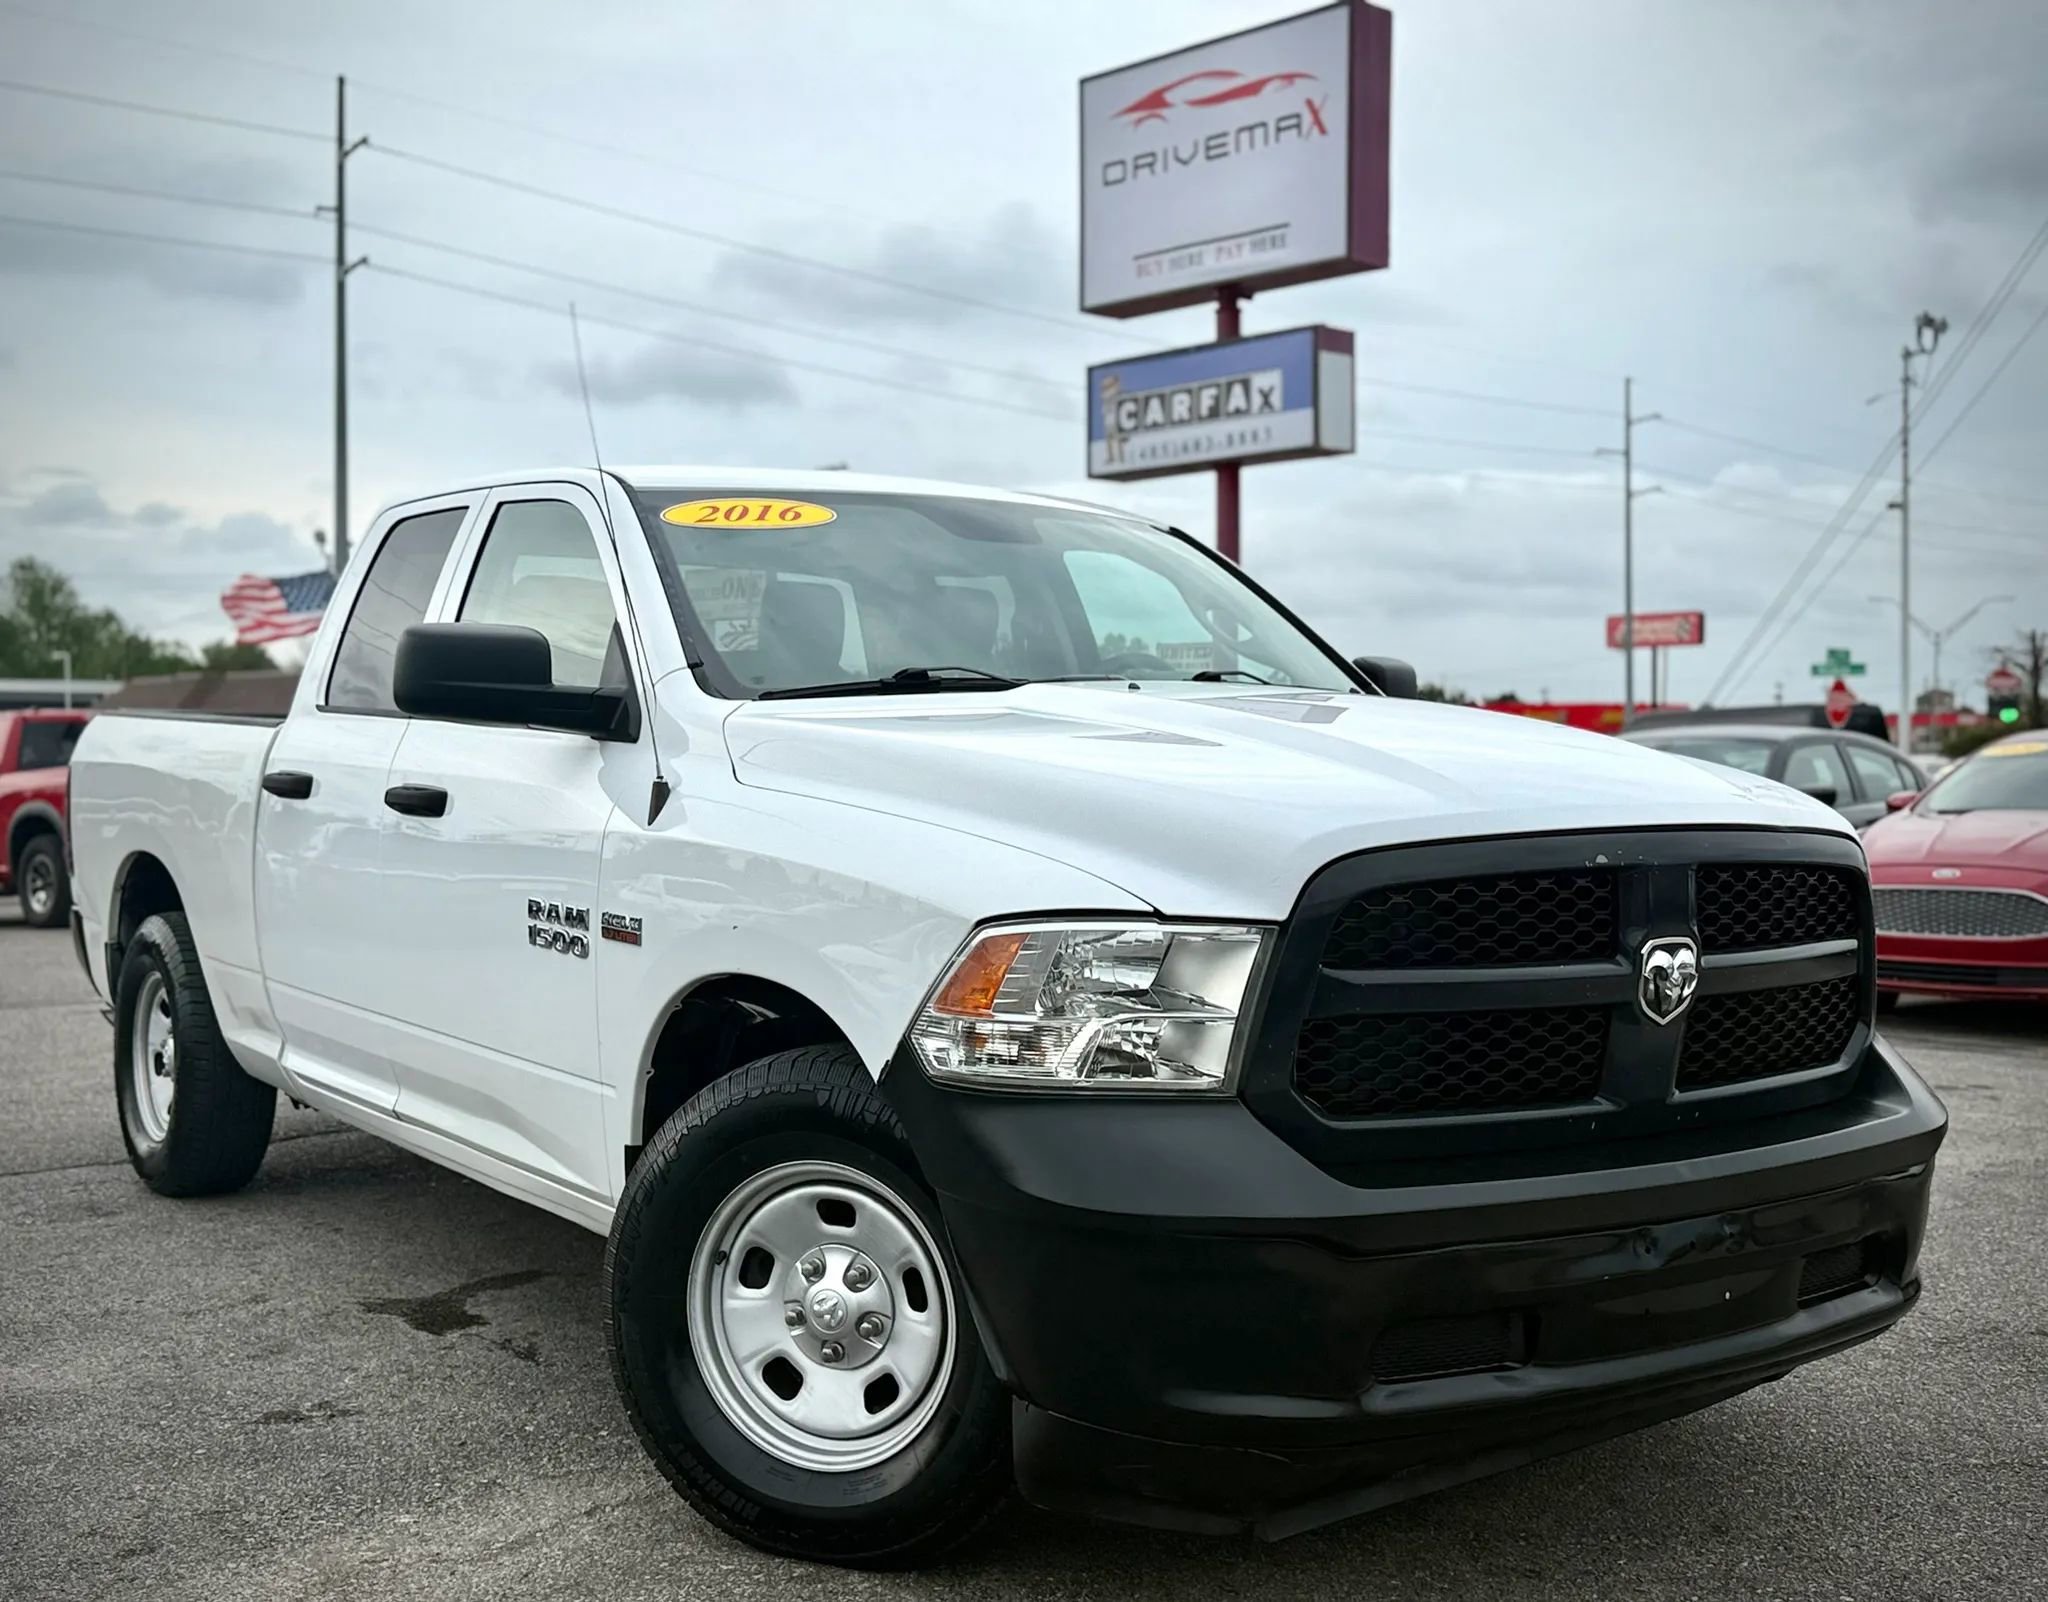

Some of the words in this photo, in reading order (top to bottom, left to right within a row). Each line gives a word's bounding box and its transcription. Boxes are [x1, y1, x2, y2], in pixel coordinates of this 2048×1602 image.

[1102, 93, 1328, 187] DRIVEMAX
[1118, 381, 1276, 431] CARFAX
[694, 504, 805, 523] 2016
[528, 898, 590, 932] RAM
[528, 923, 590, 960] 1500
